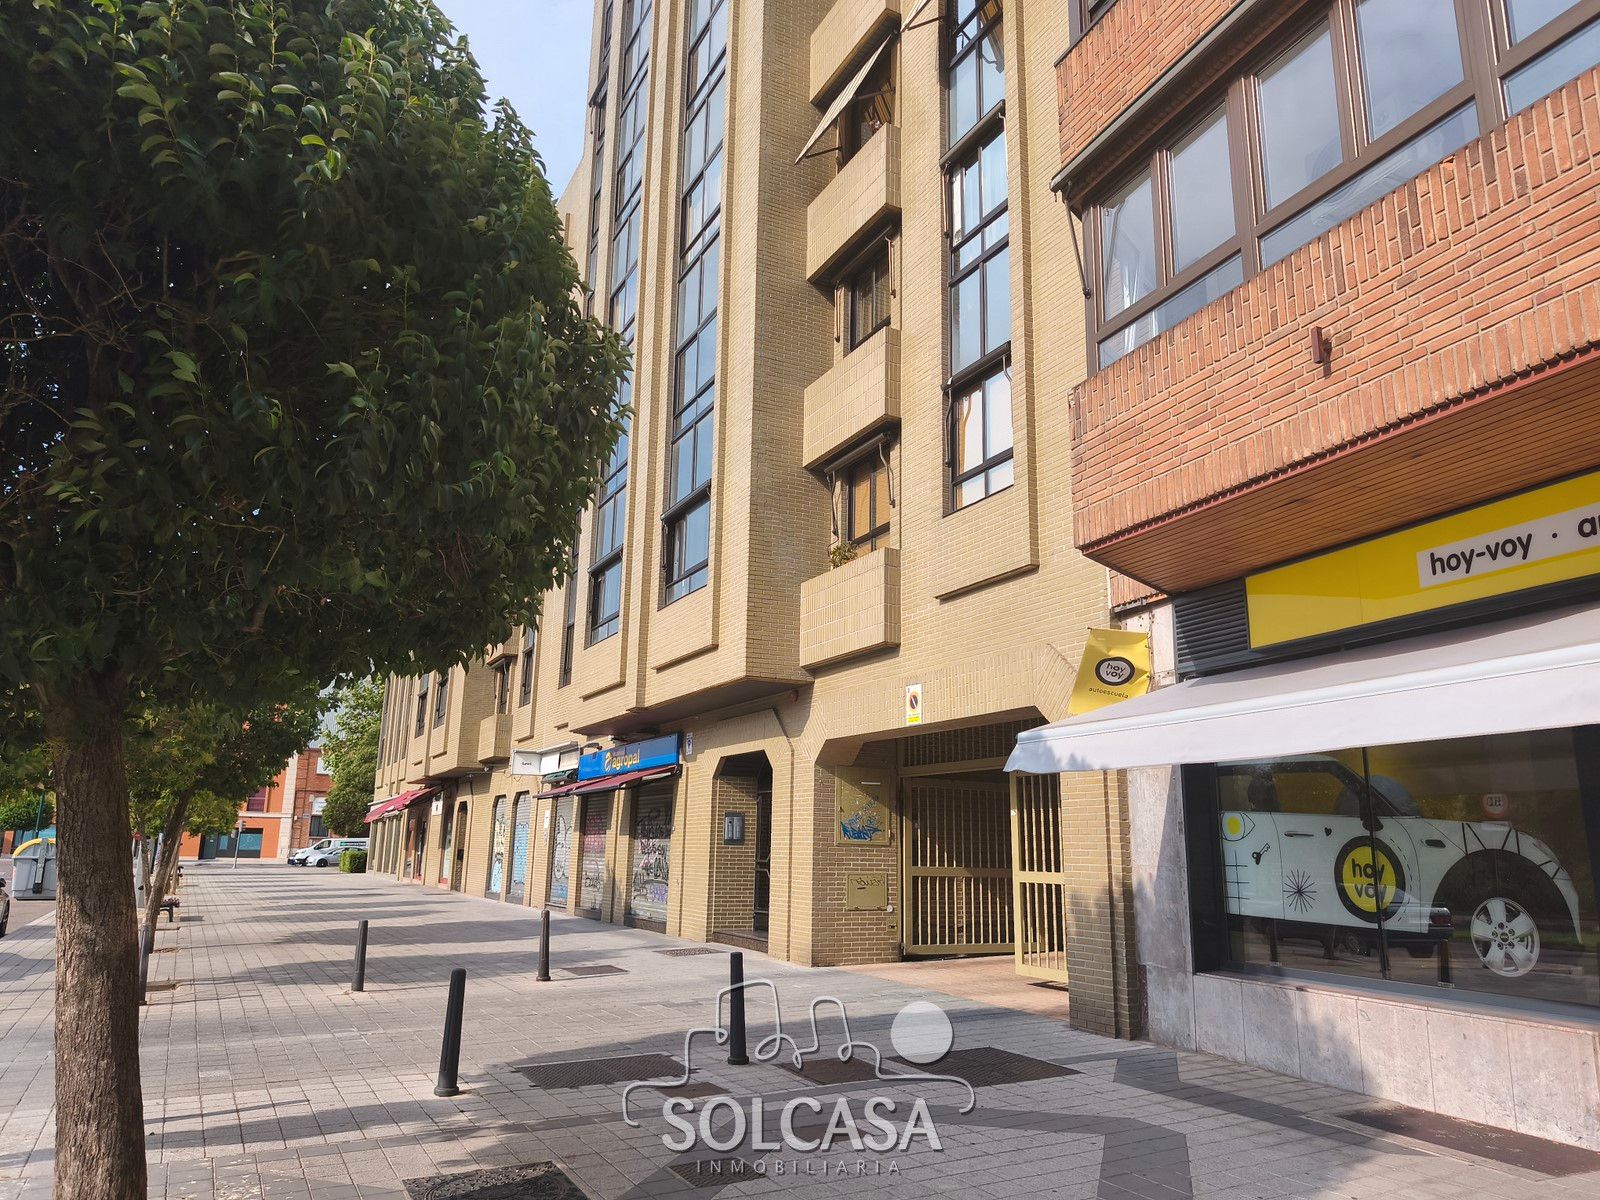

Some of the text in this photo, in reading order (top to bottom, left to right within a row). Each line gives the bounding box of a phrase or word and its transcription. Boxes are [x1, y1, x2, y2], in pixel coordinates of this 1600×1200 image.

[1430, 533, 1532, 576] hoy-voy
[1106, 662, 1126, 673] hoy
[1105, 670, 1124, 680] voy
[1088, 687, 1129, 699] autoescuela
[1351, 858, 1385, 882] hoy
